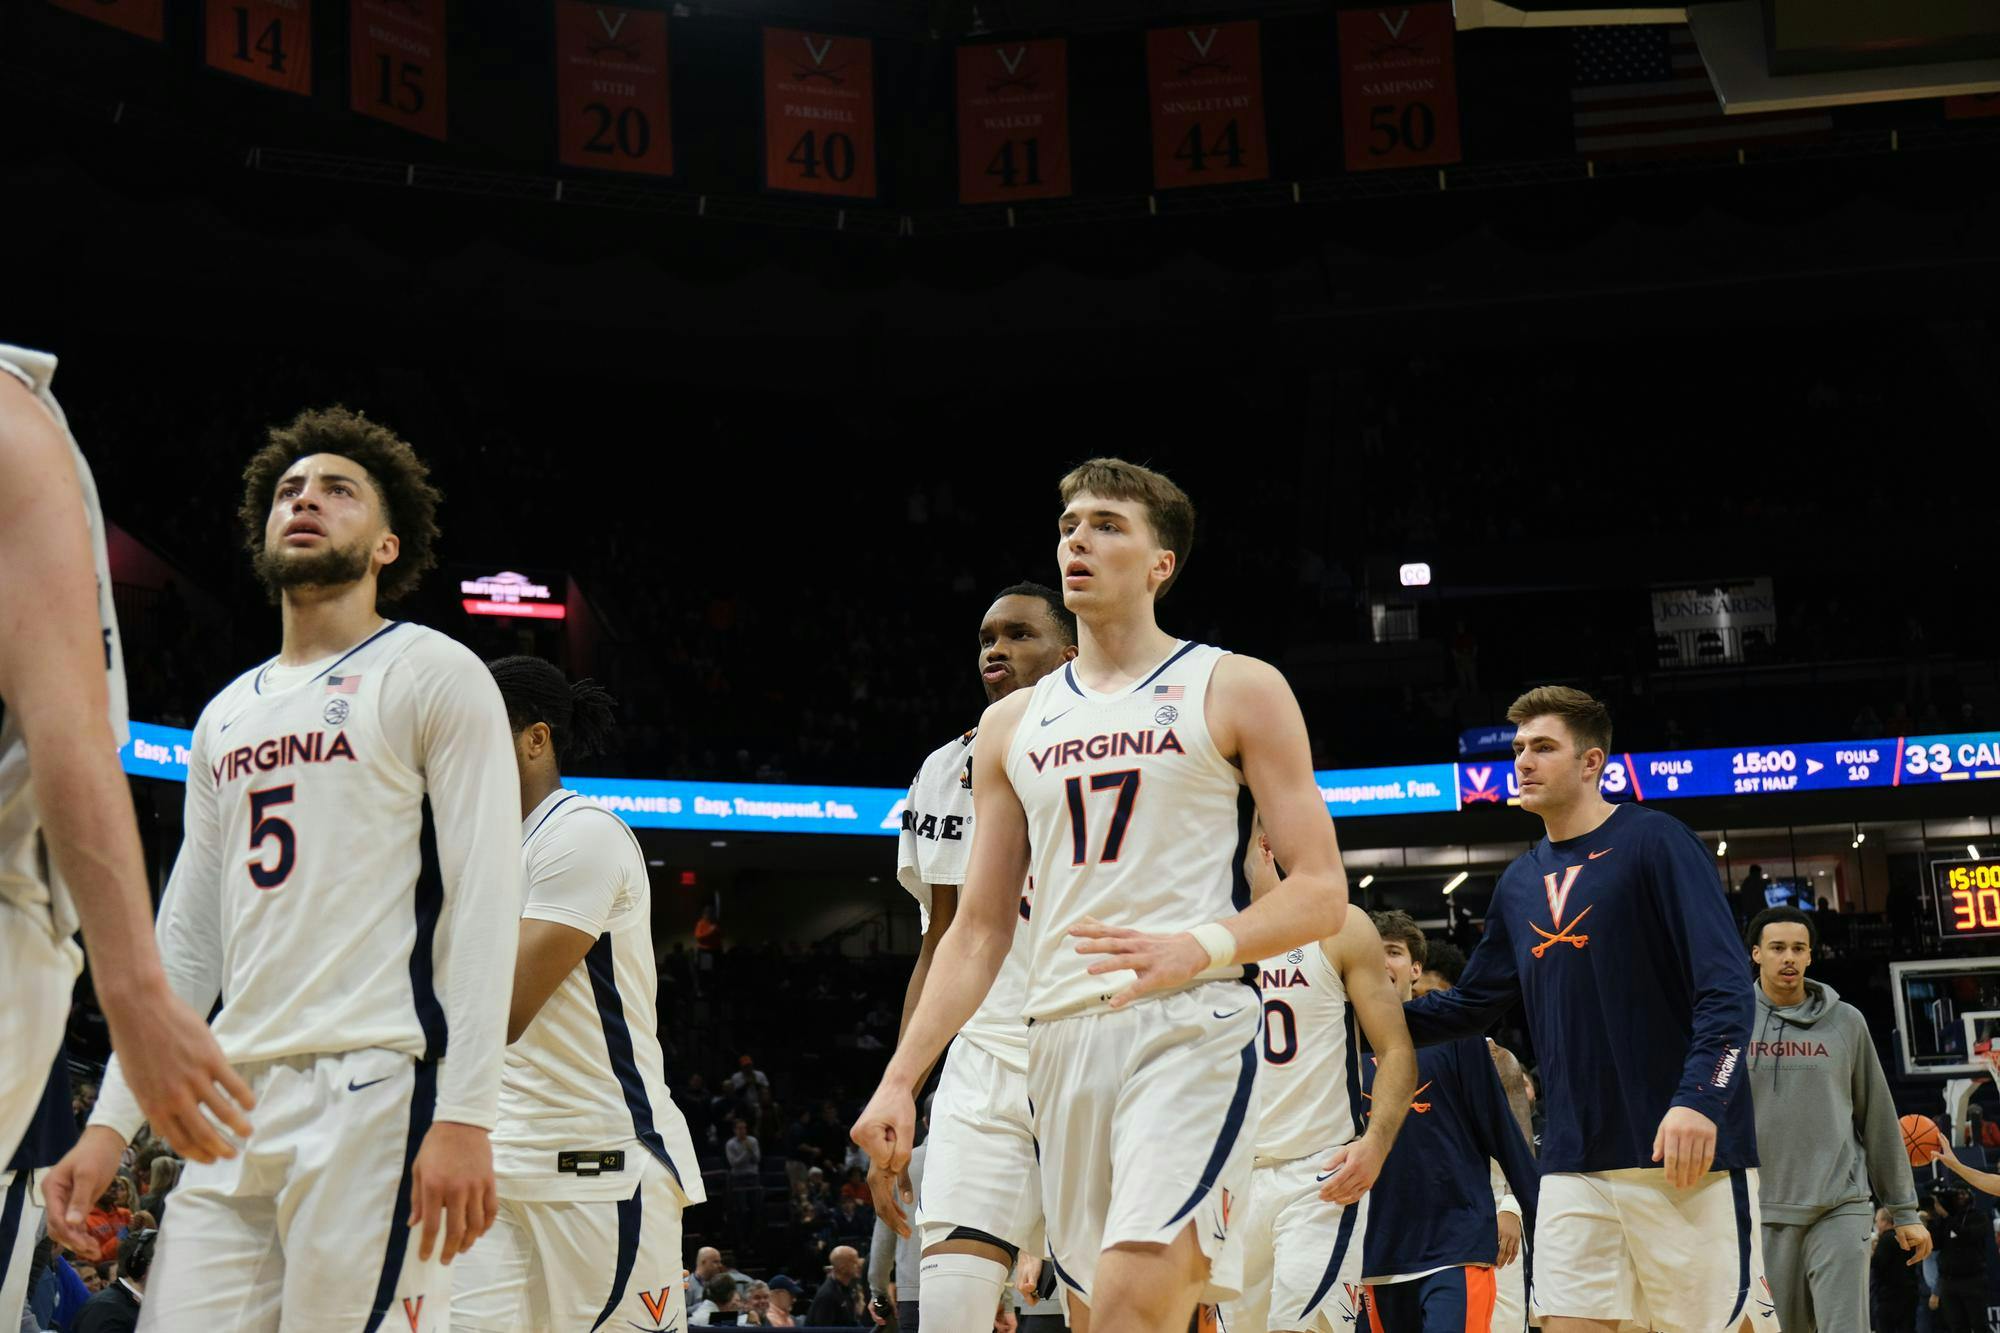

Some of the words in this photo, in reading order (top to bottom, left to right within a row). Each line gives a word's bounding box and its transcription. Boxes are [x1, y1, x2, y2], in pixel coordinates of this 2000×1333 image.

[232, 6, 287, 75] 14
[375, 53, 425, 115] 15
[1360, 78, 1436, 97] SAMPSON
[783, 103, 857, 124] PARKHILL
[1160, 96, 1249, 115] SINGLETARY
[581, 101, 650, 159] 20
[984, 113, 1043, 129] WALKER
[1367, 101, 1435, 157] 50
[787, 129, 855, 182] 40
[1173, 117, 1249, 173] 44
[985, 137, 1043, 188] 41
[1661, 600, 1713, 620] JONES
[134, 739, 172, 765] Easy.
[212, 730, 358, 788] VIRGINIA
[1027, 728, 1187, 775] VIRGINIA
[1732, 750, 1797, 775] 15:00
[1835, 749, 1880, 765] FOULS
[1905, 743, 1953, 775] 33
[1599, 762, 1628, 793] 3
[1650, 760, 1694, 776] FOULS
[1848, 765, 1870, 781] 10
[1319, 782, 1405, 804] ransparent.
[1407, 780, 1440, 798] Fun.
[1734, 778, 1760, 793] 1ST
[1762, 776, 1798, 791] HALF
[590, 795, 682, 814] MPANIES
[694, 796, 733, 818] Easy.
[734, 798, 825, 820] Transparent.
[825, 801, 857, 819] Fun.
[1064, 767, 1142, 867] 17
[247, 783, 297, 891] 5
[1949, 865, 2000, 890] 15:00
[1952, 889, 2000, 930] 30
[1260, 966, 1310, 990] NIA
[1749, 1041, 1830, 1058] IRGINIA
[1714, 1047, 1741, 1088] VIRGINIA
[603, 1156, 616, 1166] 42
